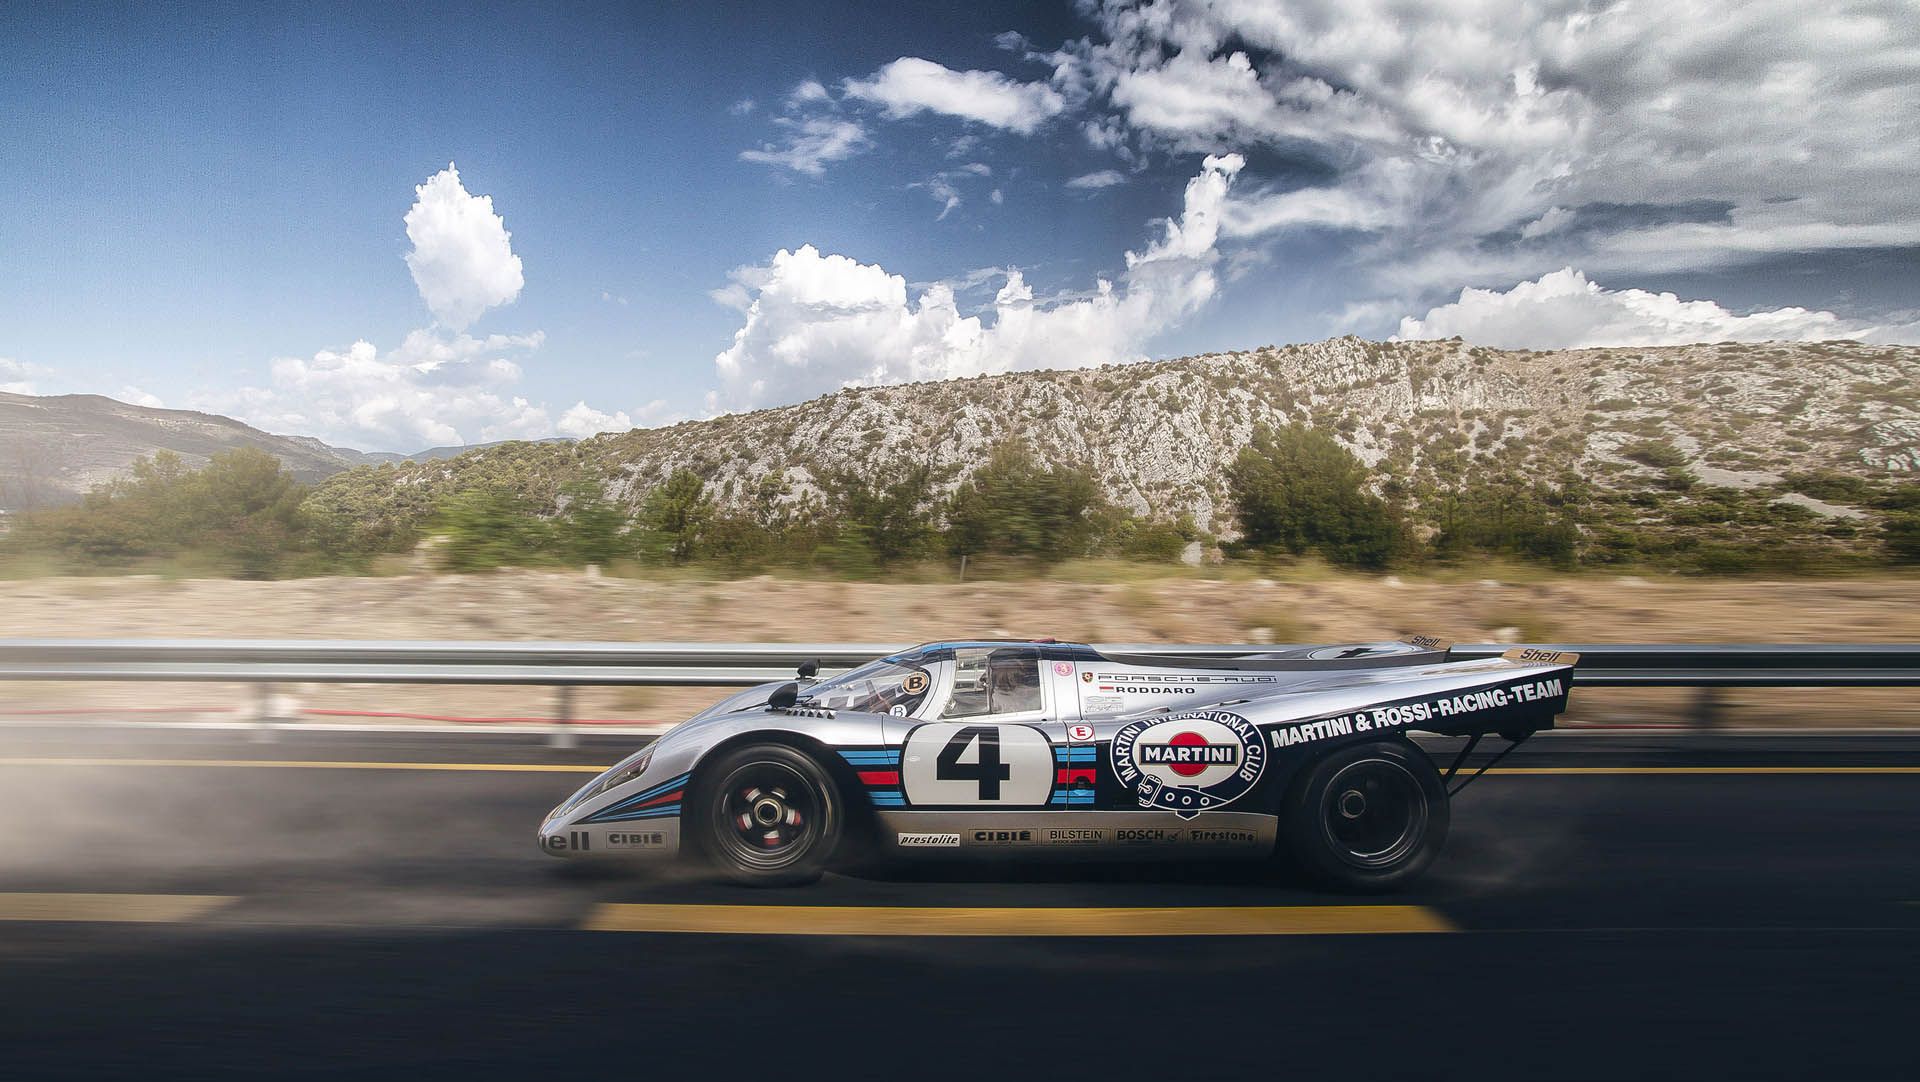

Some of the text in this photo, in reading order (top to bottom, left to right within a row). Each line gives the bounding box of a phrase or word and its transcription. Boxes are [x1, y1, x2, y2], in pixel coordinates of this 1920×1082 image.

[1411, 635, 1440, 647] Shell
[1520, 648, 1561, 662] Shell
[909, 676, 922, 689] B
[1098, 675, 1277, 683] PORSCHE-AUDI
[1271, 679, 1564, 748] MARTINI & ROSSI-RACING-TEAM
[1076, 727, 1086, 736] E
[1115, 711, 1262, 782] MARTINI INTERNATIONAL CLUB
[1145, 747, 1232, 762] MARTINI
[936, 726, 1010, 800] 4
[901, 835, 958, 845] prestolite
[1050, 830, 1102, 839] BILSTEIN
[1117, 830, 1163, 840] BOSCH
[1191, 831, 1254, 841] Firestone
